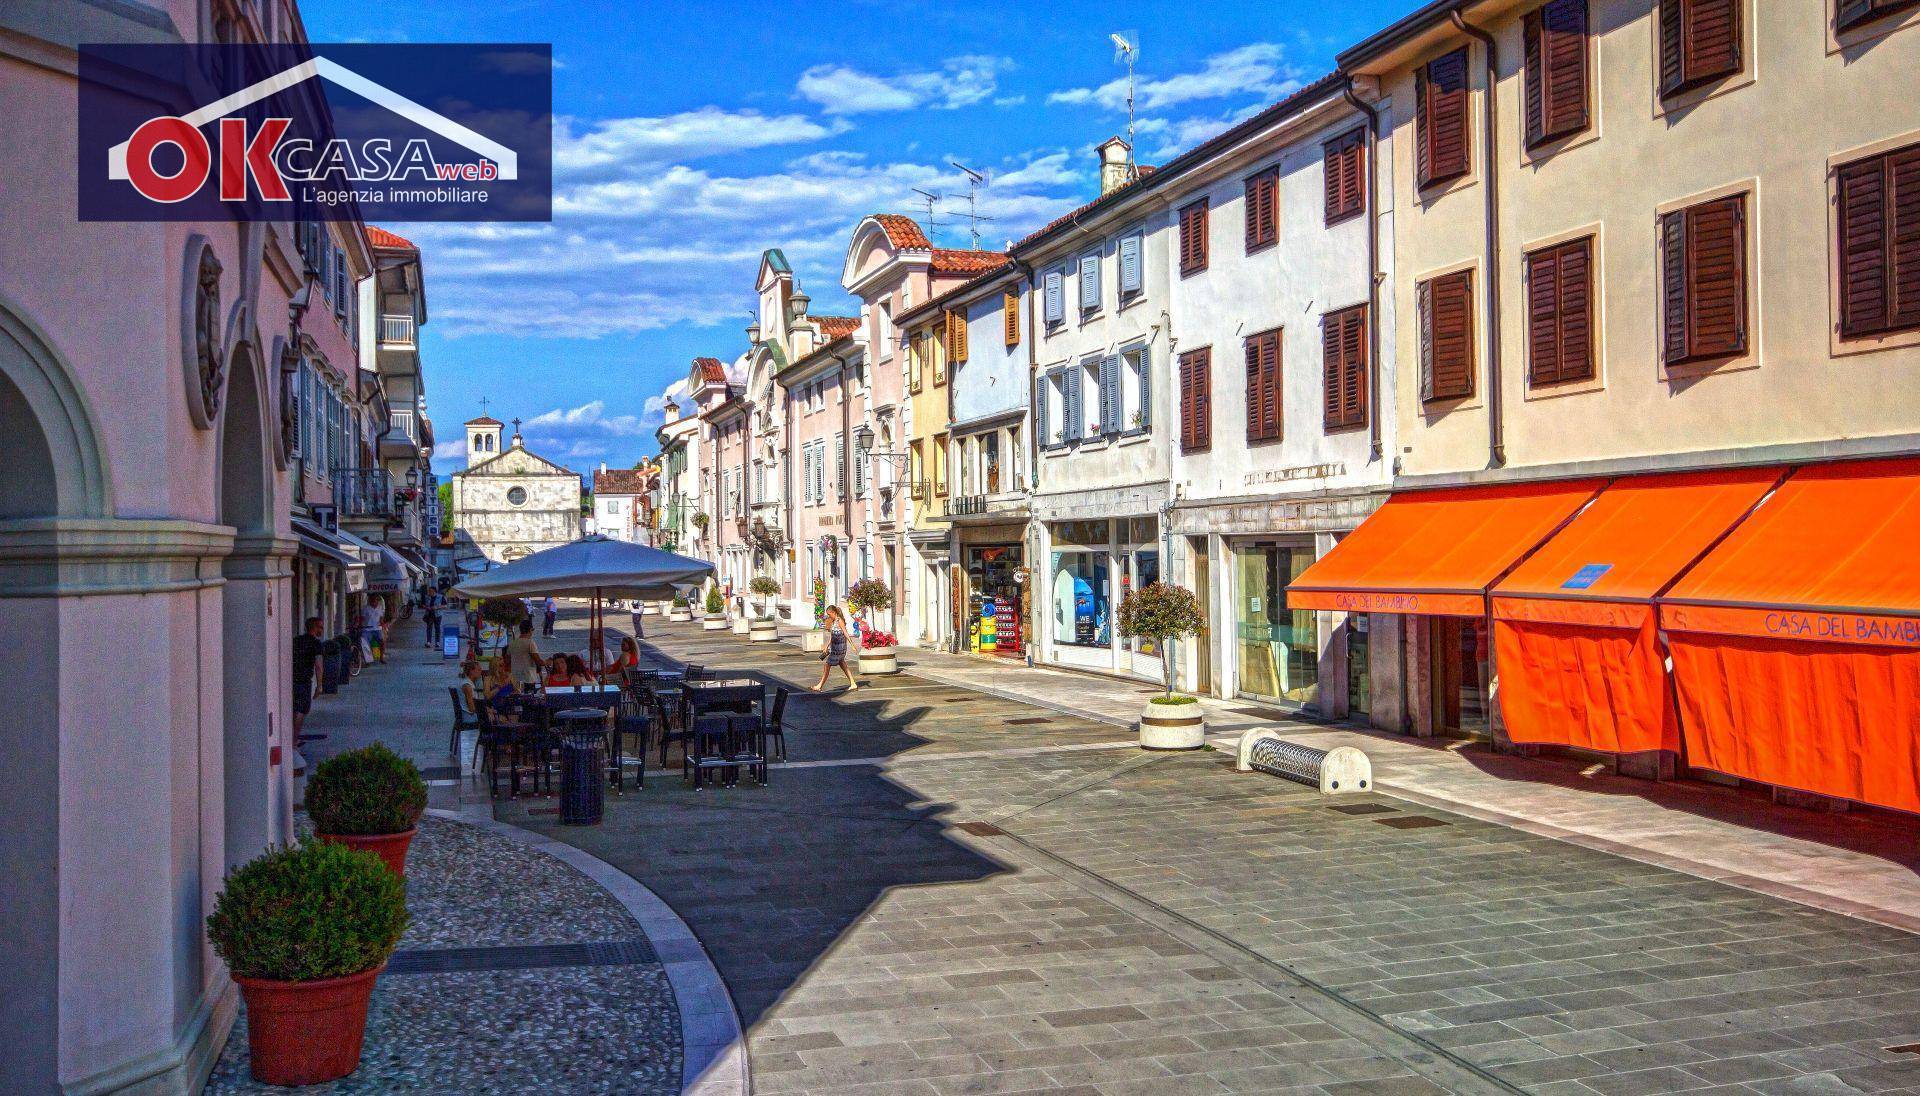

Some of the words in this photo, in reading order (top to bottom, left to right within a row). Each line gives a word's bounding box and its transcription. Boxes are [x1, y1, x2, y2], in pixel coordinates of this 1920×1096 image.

[1336, 593, 1357, 609] CASA
[1765, 613, 1812, 634] CASA
[1818, 616, 1849, 638] DEL
